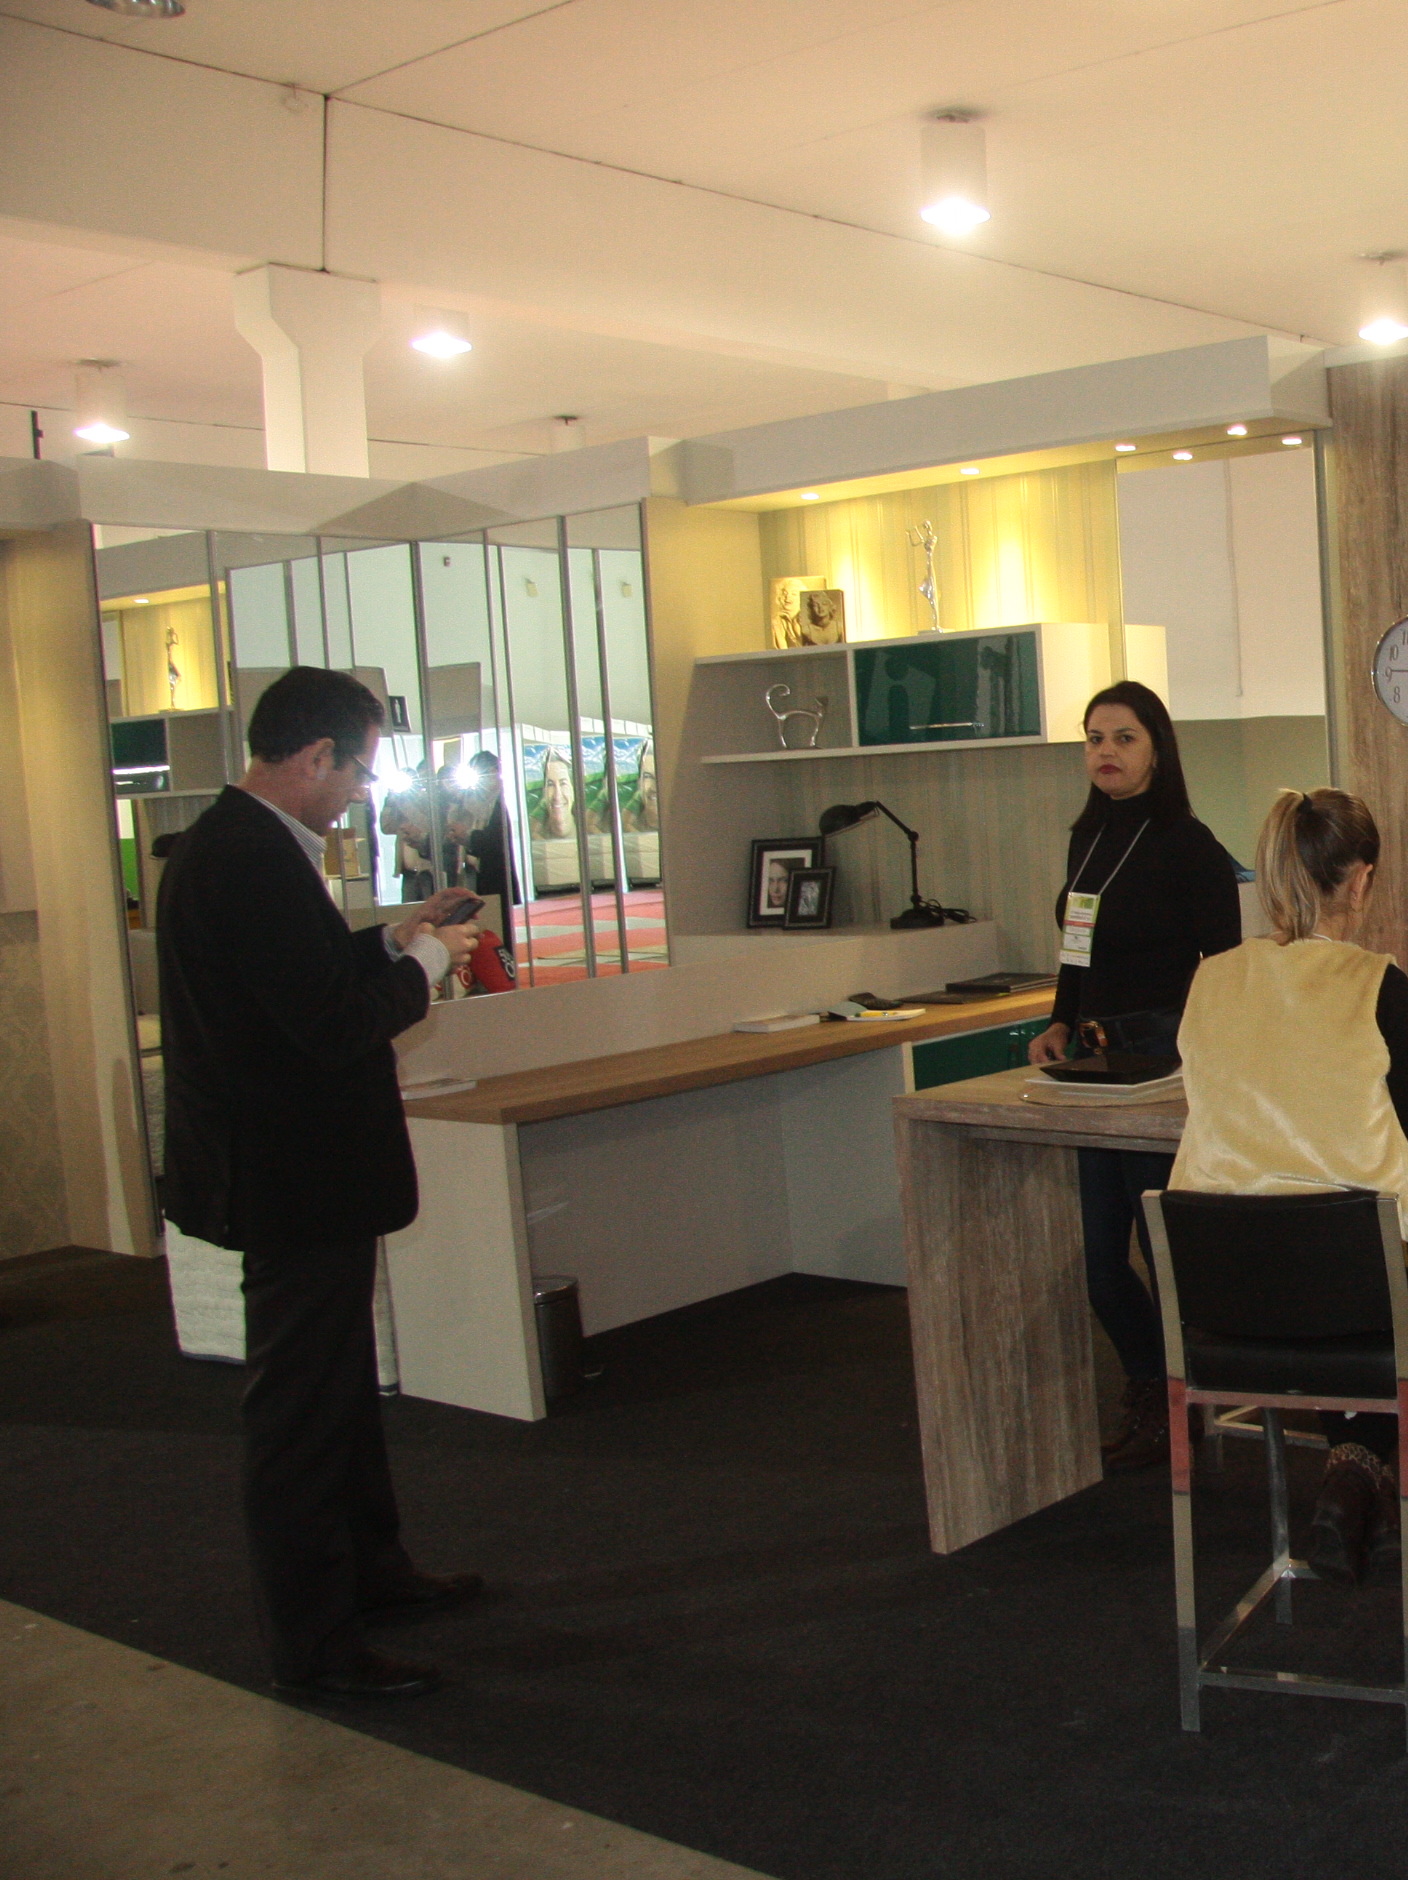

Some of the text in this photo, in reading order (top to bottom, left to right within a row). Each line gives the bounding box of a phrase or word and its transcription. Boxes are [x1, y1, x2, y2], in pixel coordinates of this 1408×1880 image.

[1390, 644, 1399, 661] 10
[1385, 667, 1392, 683] 9
[1393, 686, 1400, 703] 8
